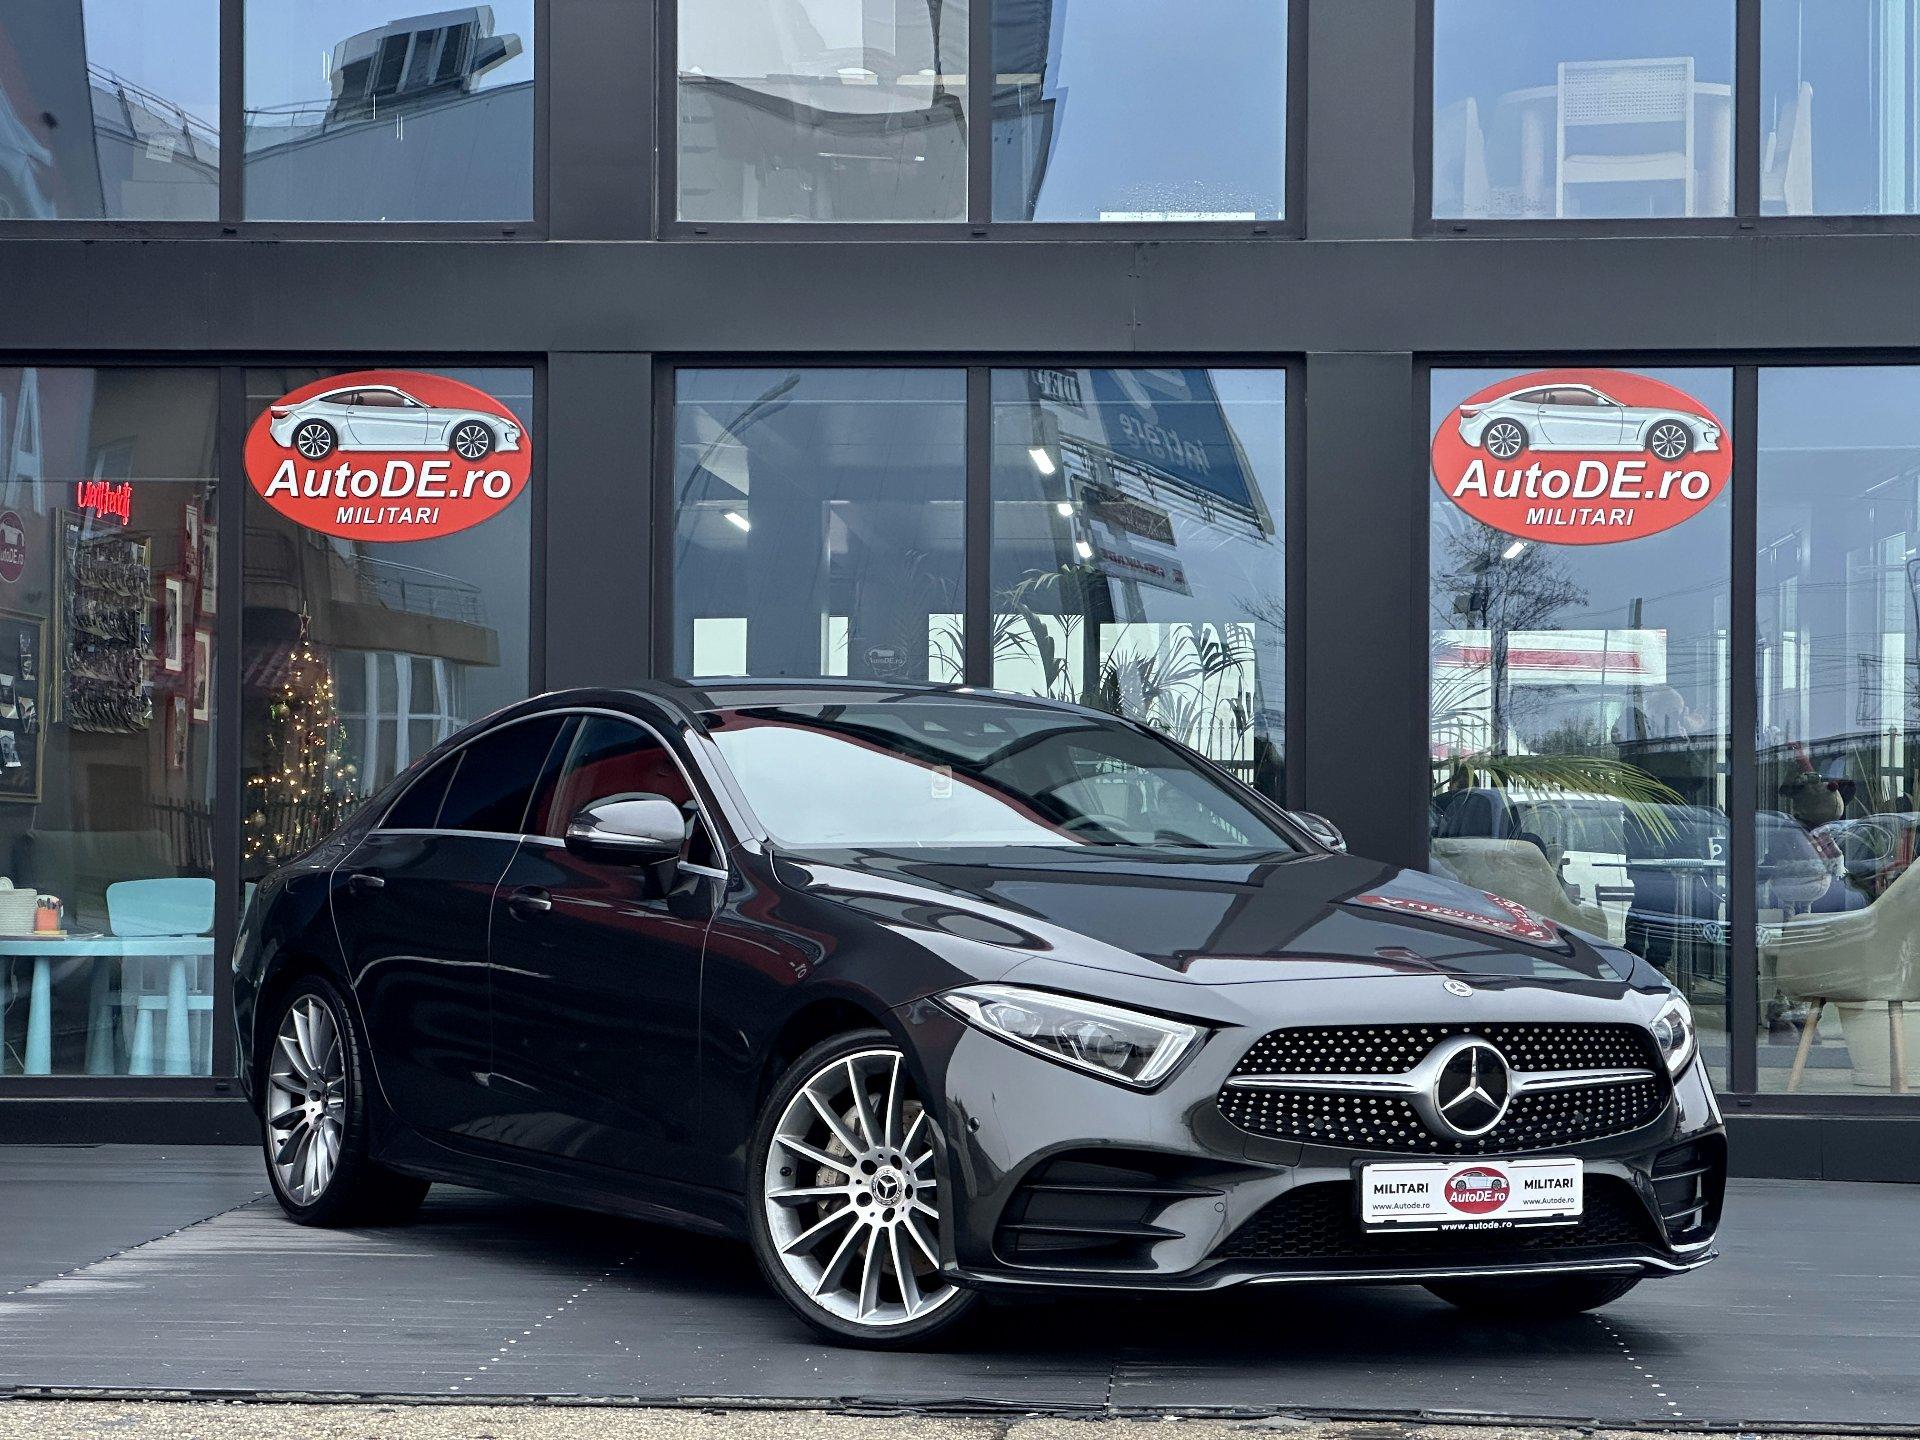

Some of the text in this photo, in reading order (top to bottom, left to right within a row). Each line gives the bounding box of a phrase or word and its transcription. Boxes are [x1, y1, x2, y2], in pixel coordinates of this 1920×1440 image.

[264, 459, 511, 499] AutoDE.ro
[1452, 459, 1710, 500] AutoDE.ro
[336, 507, 439, 525] MILITARI
[1525, 507, 1634, 526] MILITARI
[1373, 1183, 1429, 1195] MILITARI
[1524, 1178, 1574, 1190] MILITARI
[1449, 1190, 1506, 1203] AutoDE.ro
[1523, 1196, 1575, 1206] www.Autode.ro
[1372, 1201, 1431, 1211] www.Autode.ro
[1440, 1221, 1513, 1231] www.autode.ro
